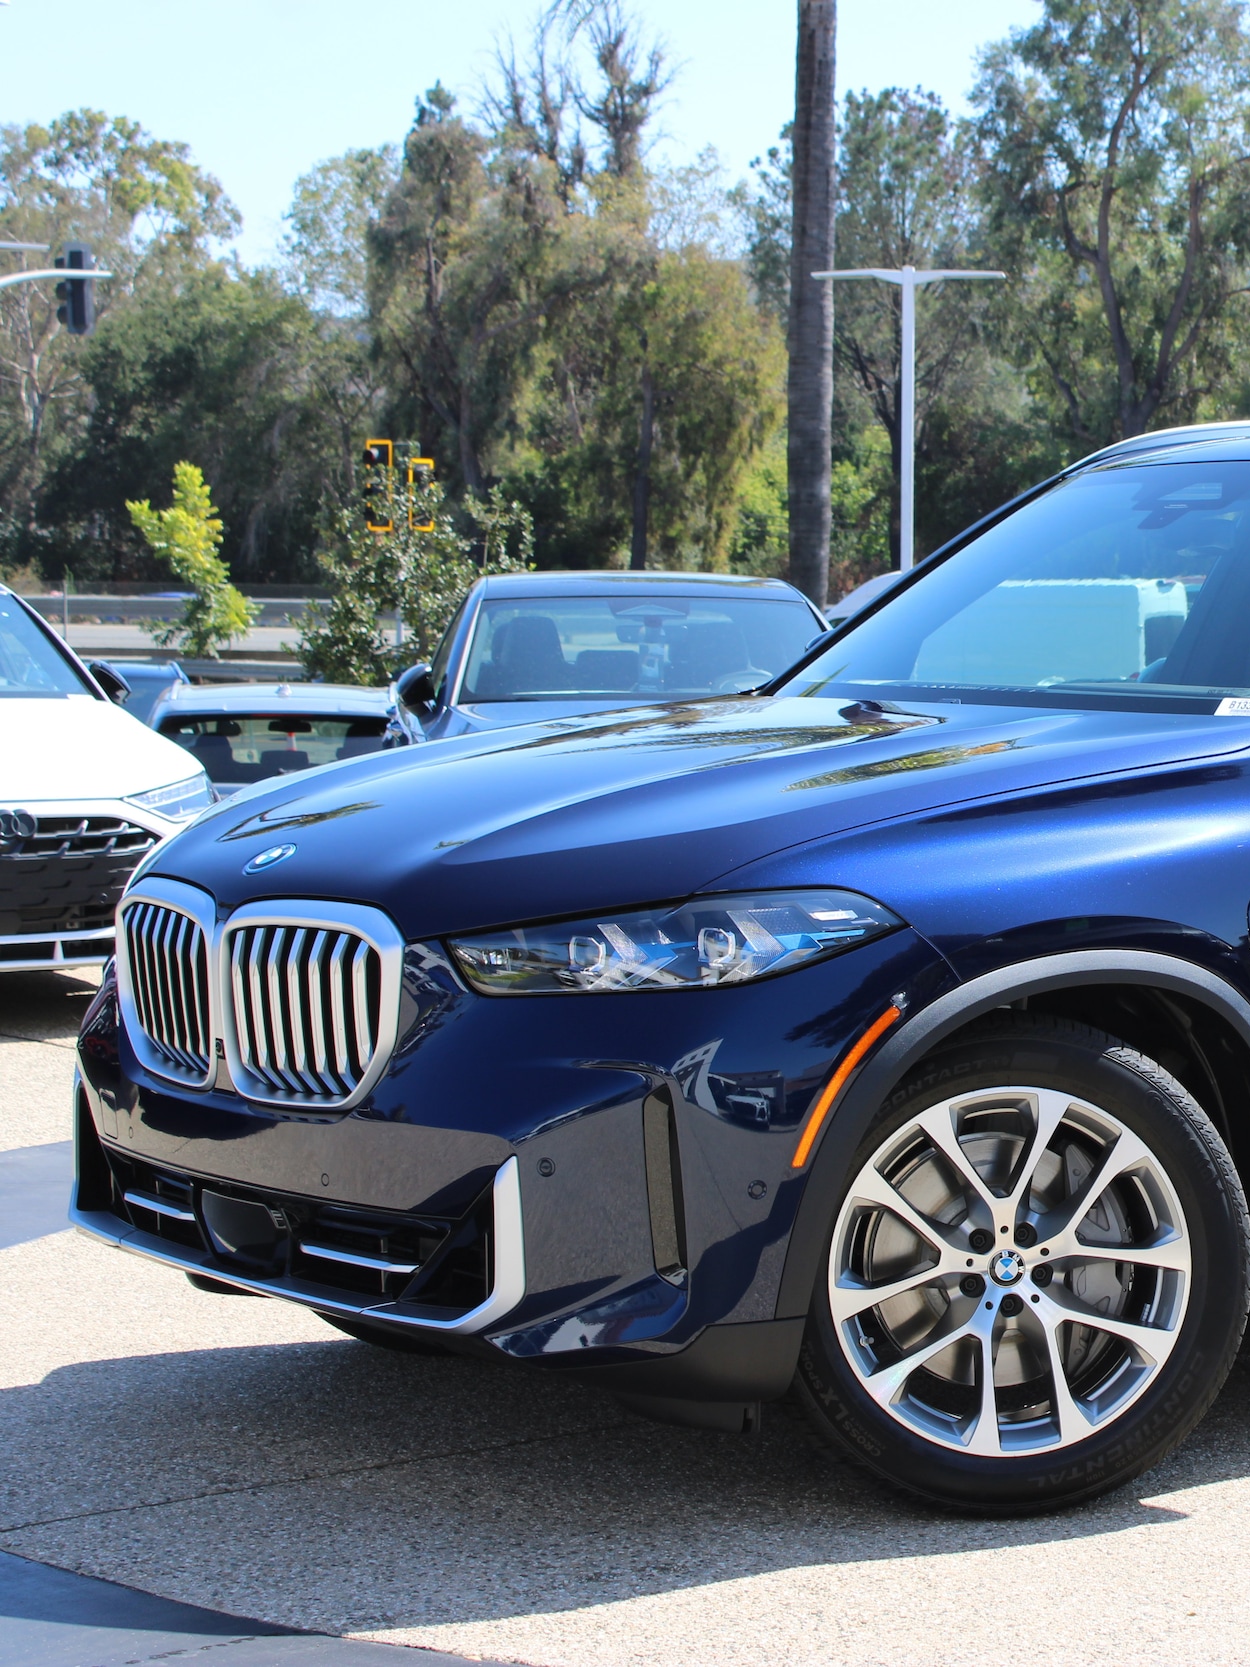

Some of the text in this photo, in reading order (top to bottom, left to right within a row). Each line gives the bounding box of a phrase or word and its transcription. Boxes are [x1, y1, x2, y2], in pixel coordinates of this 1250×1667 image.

[1001, 1251, 1025, 1274] BMW
[1027, 1351, 1205, 1488] CONTINENTAL
[841, 1420, 882, 1458] CROSS
